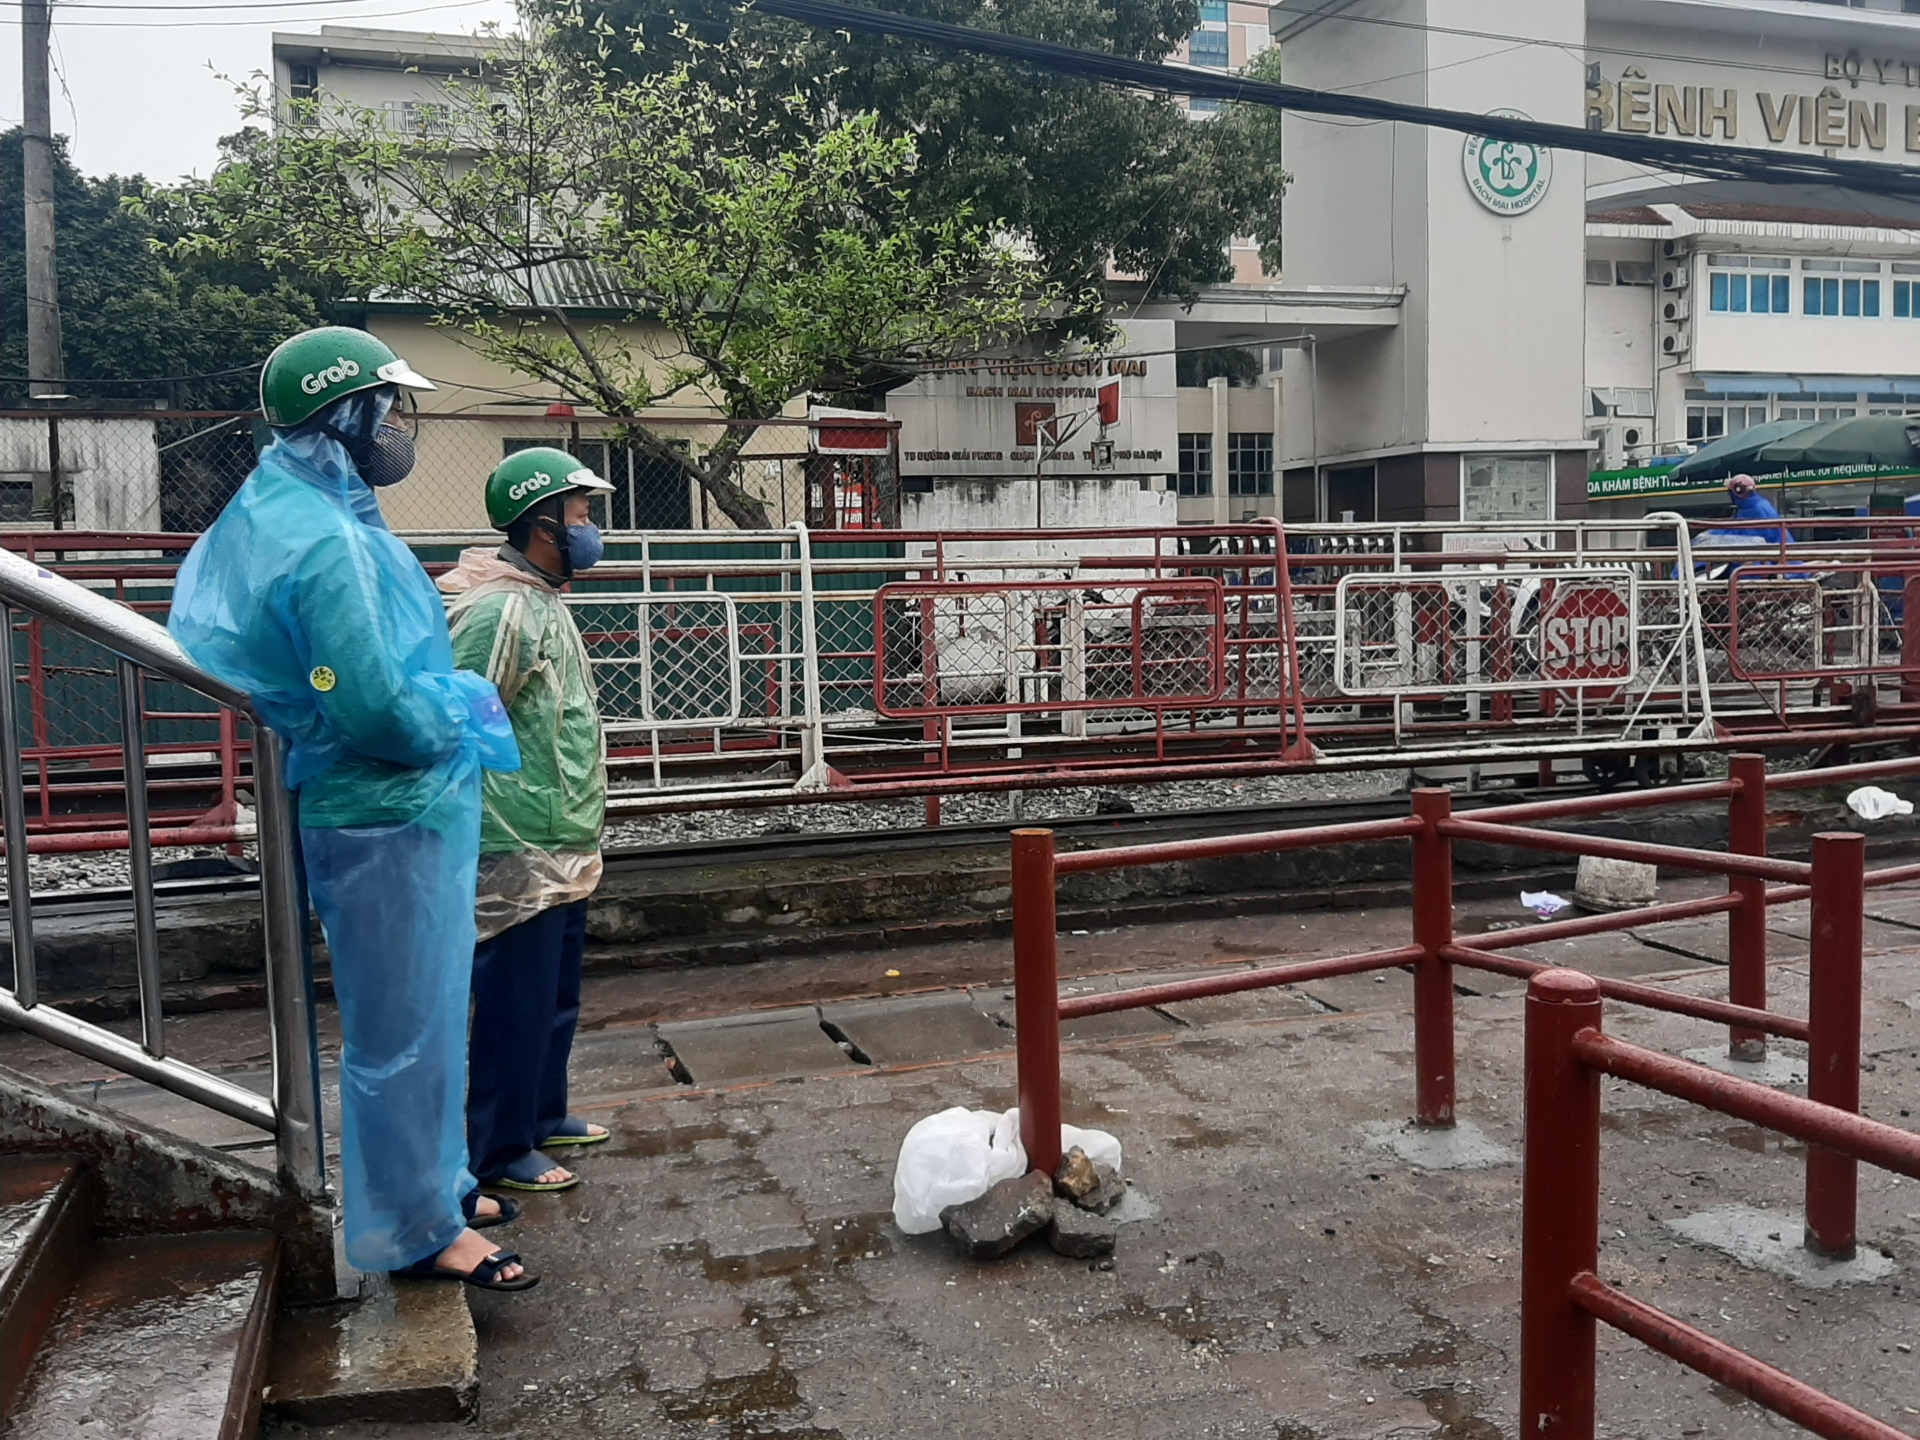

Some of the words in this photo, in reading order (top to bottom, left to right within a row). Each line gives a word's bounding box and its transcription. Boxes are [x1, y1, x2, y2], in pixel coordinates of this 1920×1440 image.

[1493, 198, 1509, 210] MAI
[1511, 179, 1545, 210] HOSPITAL
[301, 356, 360, 395] Grab
[1108, 360, 1148, 377] MAI
[966, 387, 1003, 398] BACH
[1008, 387, 1033, 398] MAI
[1036, 386, 1097, 398] HOSPITA
[509, 470, 551, 501] Grab
[1602, 477, 1630, 492] KHÁM
[1632, 475, 1659, 492] BỆNH
[1547, 616, 1629, 668] STOP
